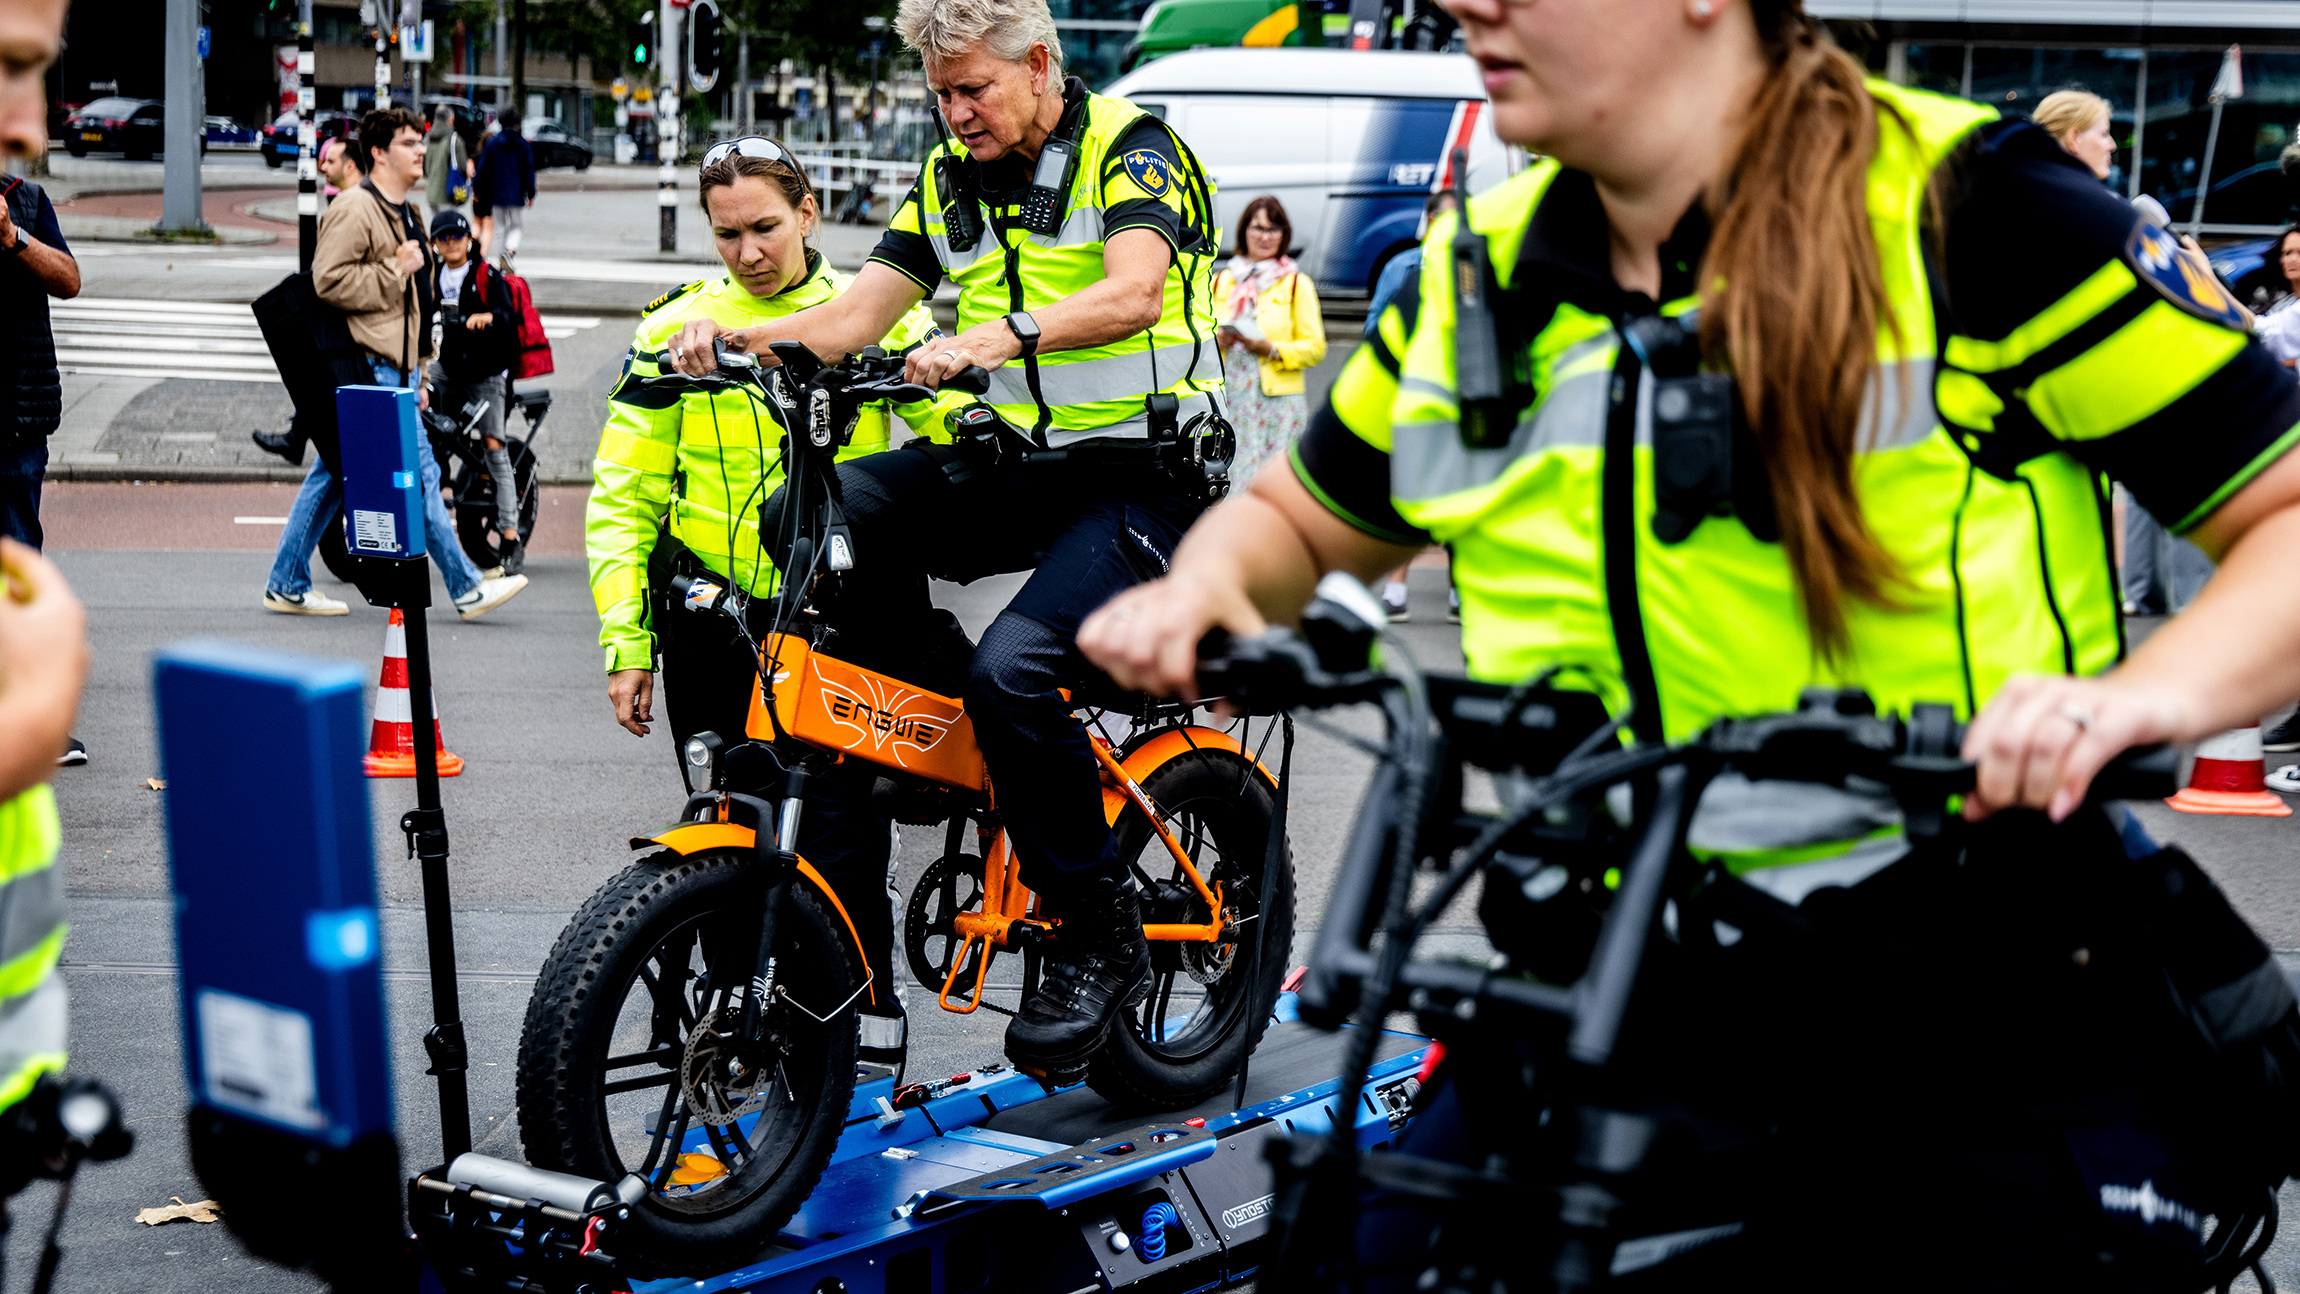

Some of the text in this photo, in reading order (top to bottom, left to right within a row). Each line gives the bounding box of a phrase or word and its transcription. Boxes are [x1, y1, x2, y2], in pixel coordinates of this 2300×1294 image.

[1129, 156, 1166, 169] POLITIE
[814, 397, 827, 439] ABUS
[833, 695, 935, 746] ENGWE
